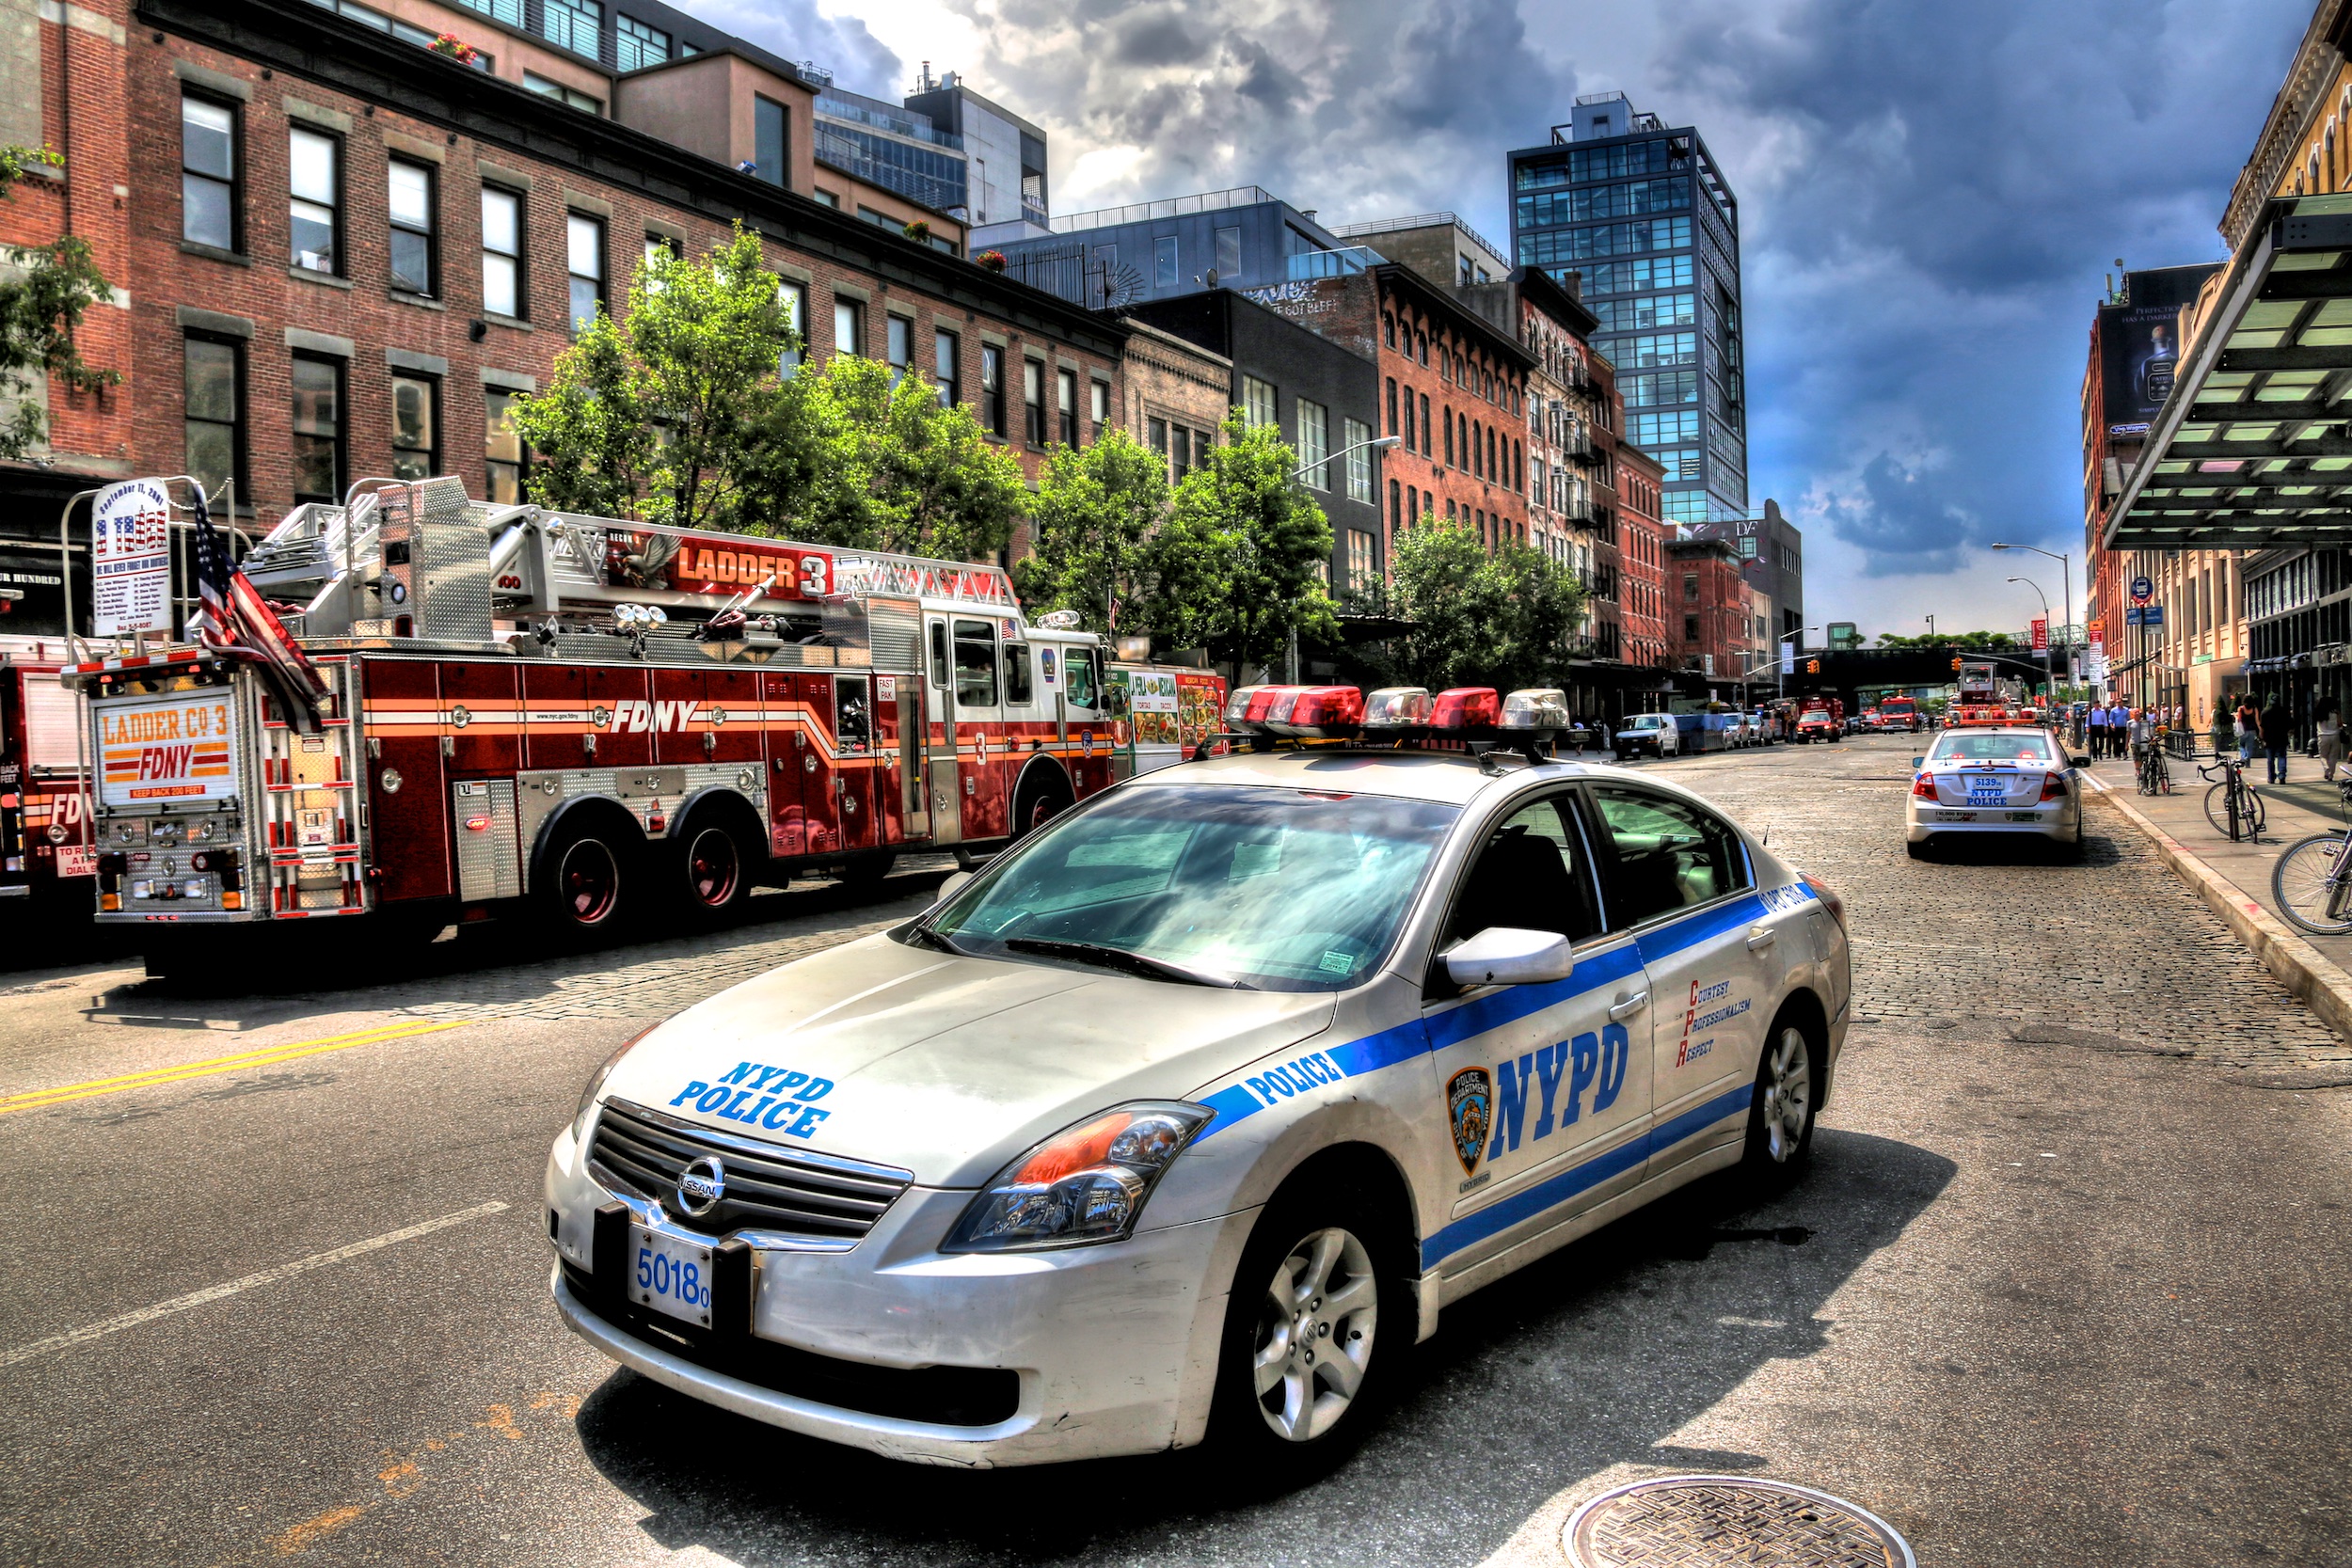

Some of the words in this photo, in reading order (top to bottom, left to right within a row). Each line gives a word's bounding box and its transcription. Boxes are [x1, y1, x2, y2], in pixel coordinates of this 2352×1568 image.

[13, 574, 61, 585] HUNDRED
[678, 546, 795, 588] LADDER
[801, 555, 827, 597] 3
[879, 679, 894, 689] FAST
[881, 690, 893, 700] PAK
[103, 709, 181, 746] LADDER
[215, 705, 229, 736] 3
[610, 701, 699, 734] FDNY
[139, 744, 194, 781] FDNY
[975, 732, 987, 766] 3
[0, 774, 18, 784] FEET
[133, 789, 151, 799] KEEP
[151, 788, 170, 797] BACK
[171, 786, 184, 796] 200
[184, 785, 203, 795] FEET
[1976, 778, 1996, 786] 5139
[1966, 798, 2008, 806] POLICE
[59, 847, 73, 857] TO
[66, 864, 88, 876] DIAL
[1690, 980, 1730, 1006] COURTESY
[1683, 998, 1752, 1037] PROFESSIONALISM
[1676, 1038, 1714, 1069] RESPECT
[719, 1061, 834, 1103] NYPD
[1245, 1053, 1343, 1105] POLICE
[1455, 1071, 1480, 1087] POLICE
[1487, 1022, 1629, 1163] NYPD
[669, 1080, 833, 1140] POLICE
[1450, 1083, 1489, 1110] DEPARTMENT
[1482, 1102, 1490, 1131] YORK
[1453, 1121, 1463, 1146] CITY
[1459, 1148, 1468, 1159] OF
[678, 1179, 715, 1197] NISSAN
[1464, 1173, 1489, 1191] HYBRID
